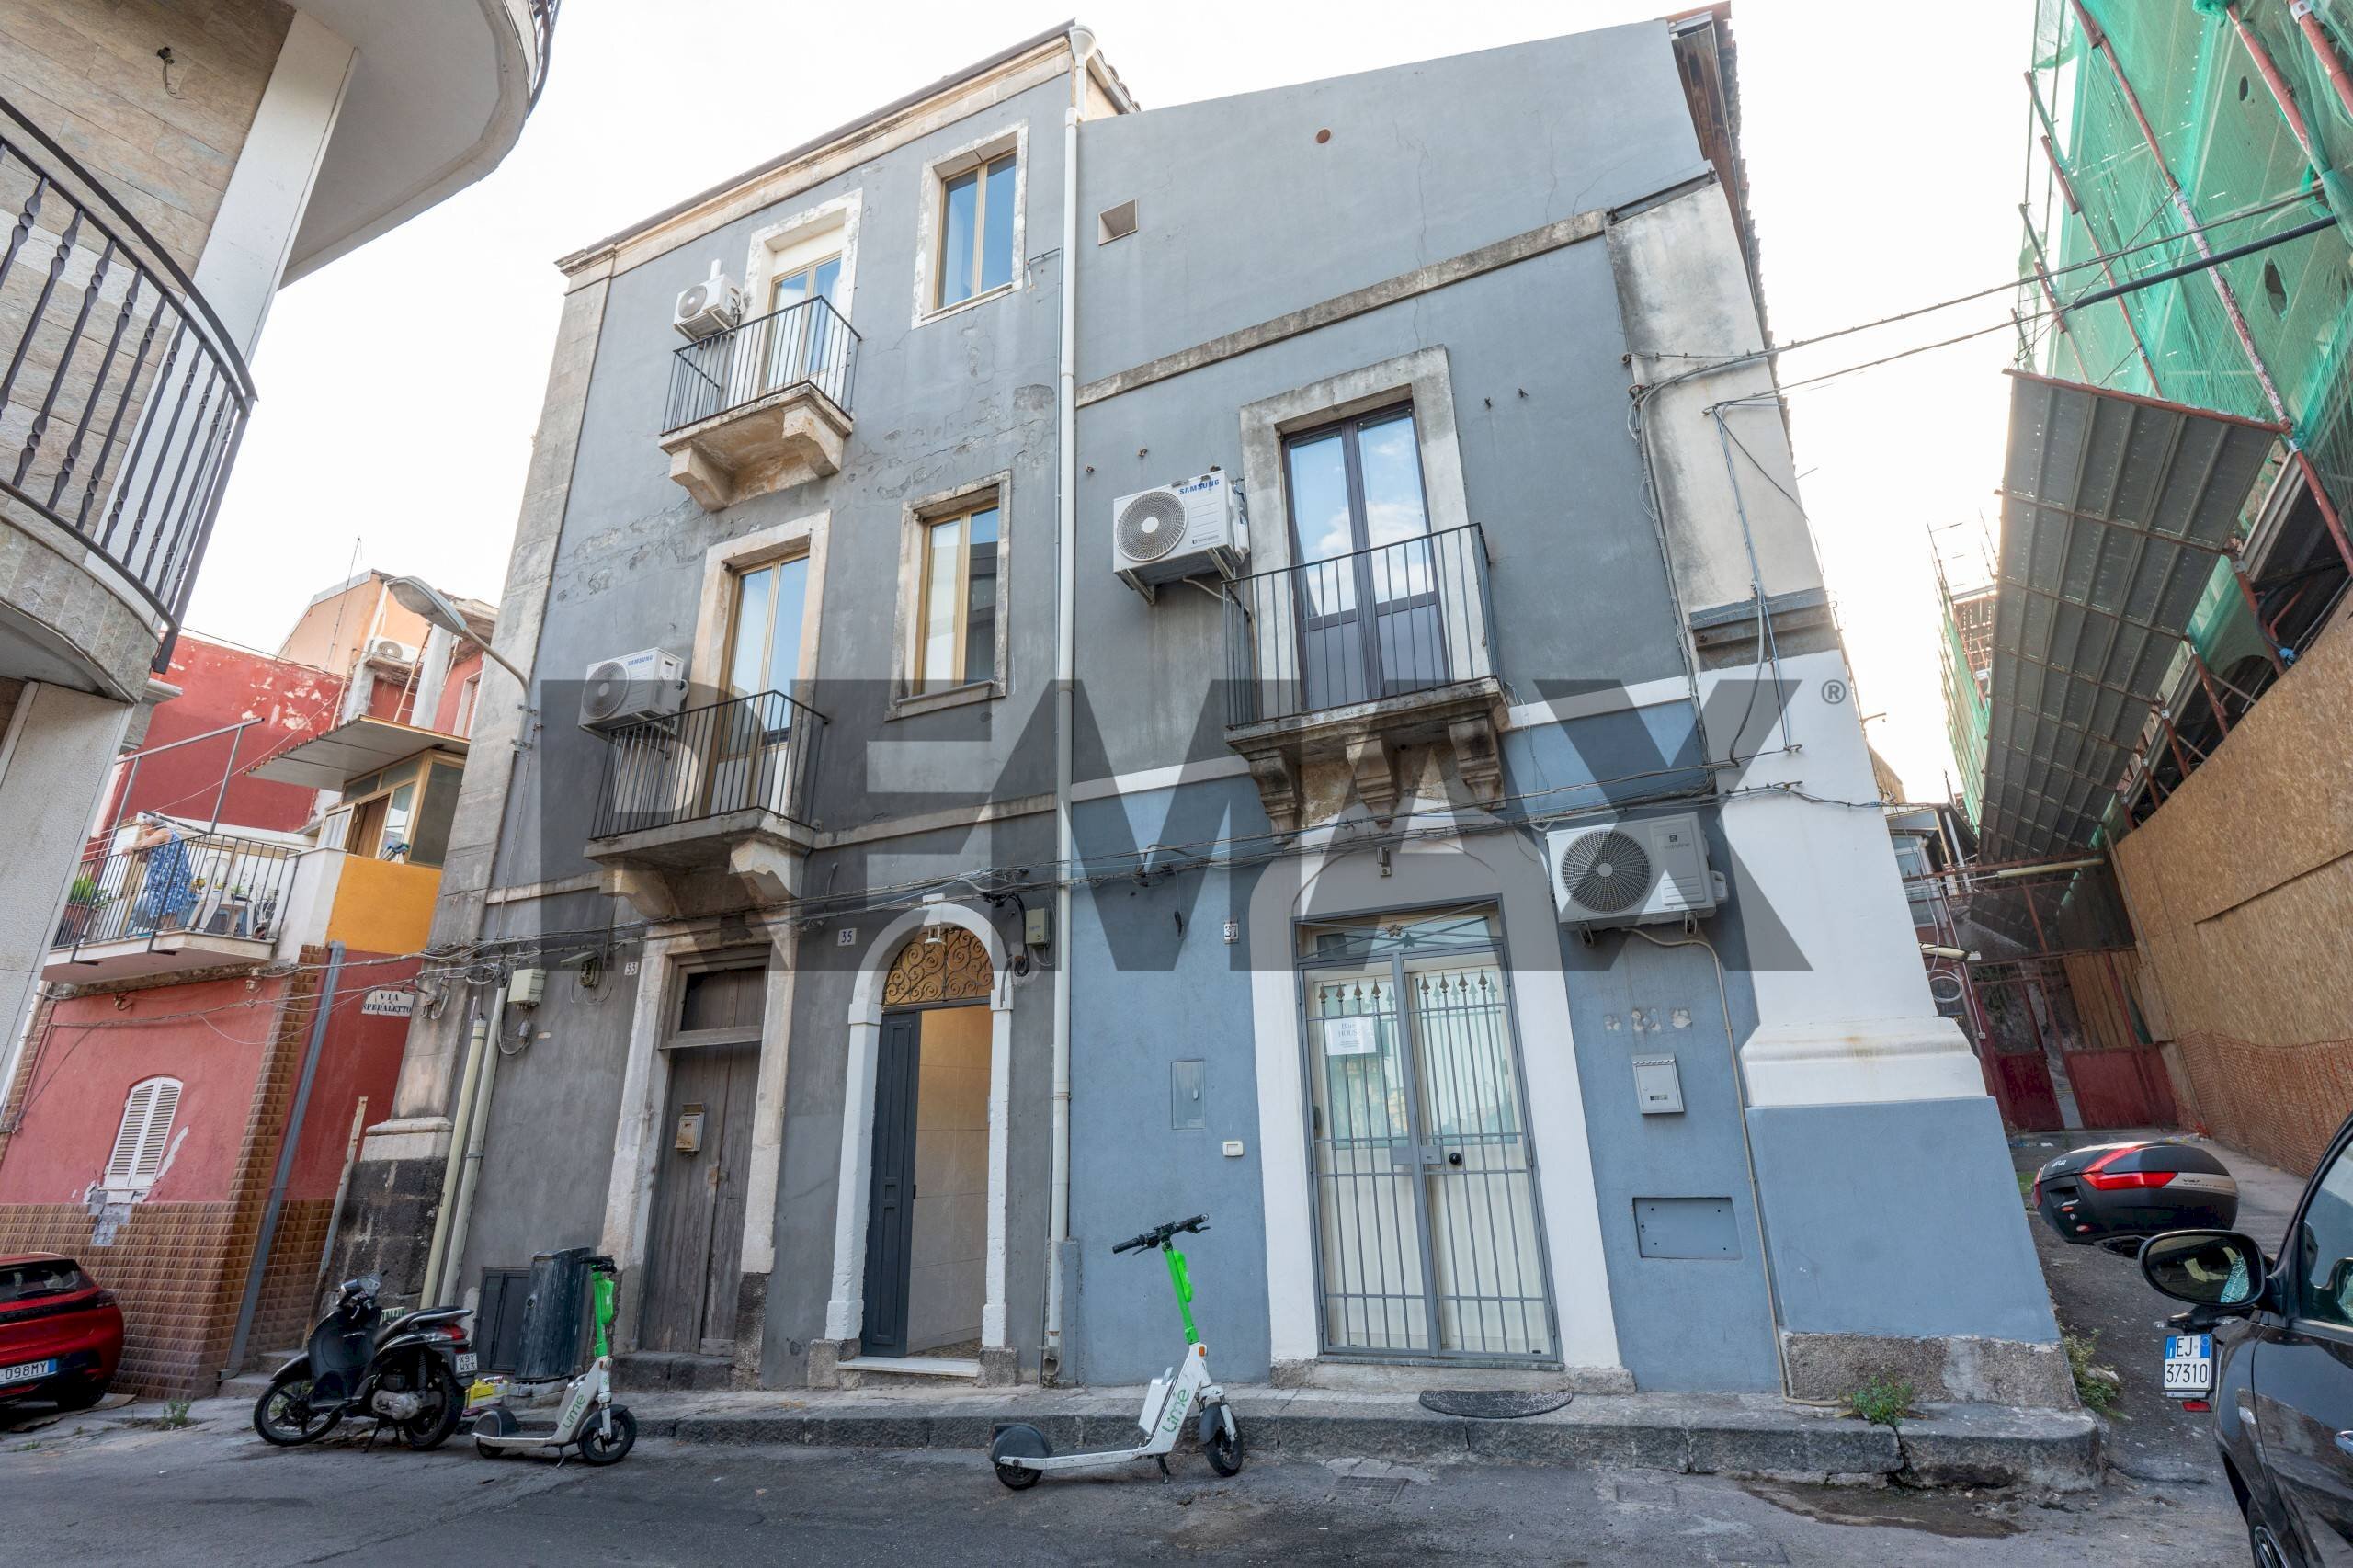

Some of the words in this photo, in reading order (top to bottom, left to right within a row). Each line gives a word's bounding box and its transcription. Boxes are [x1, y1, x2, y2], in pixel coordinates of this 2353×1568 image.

[1180, 479, 1220, 494] SAMSUNG
[841, 930, 853, 943] 35
[380, 993, 399, 1001] VIA
[2176, 1337, 2193, 1357] EJ
[5, 1361, 47, 1380] 098MY
[2166, 1363, 2208, 1383] 37310
[563, 1395, 585, 1428] Lime
